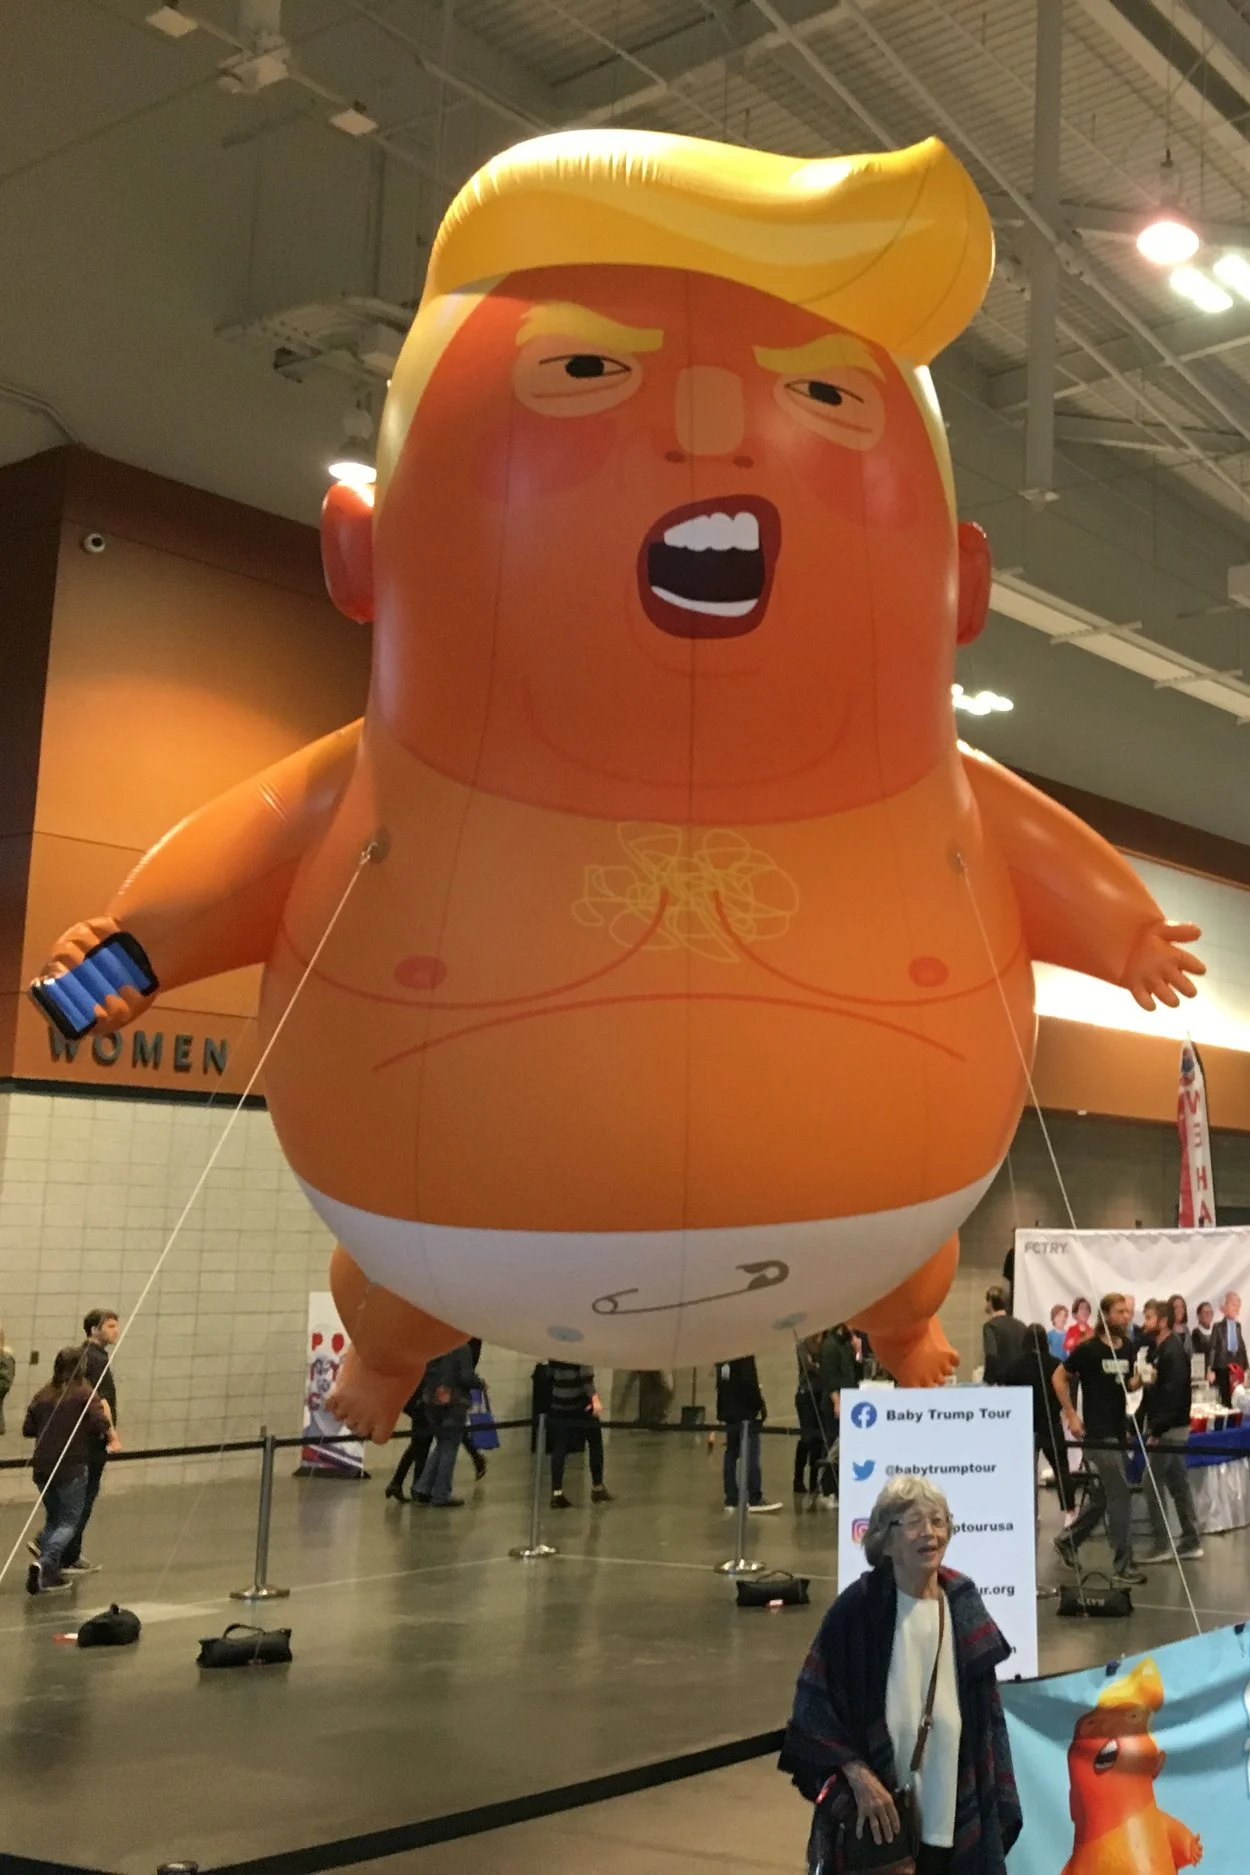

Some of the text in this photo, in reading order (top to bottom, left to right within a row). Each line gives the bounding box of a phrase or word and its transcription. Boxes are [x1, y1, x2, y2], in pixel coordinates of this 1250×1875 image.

[48, 1027, 229, 1075] WOMEN
[1024, 1241, 1068, 1255] FCTRY
[886, 1407, 1011, 1423] Baby Trump Tour
[885, 1463, 997, 1477] @babytrumptour
[952, 1522, 1014, 1535] ptourusa
[979, 1584, 1015, 1597] ur.org
